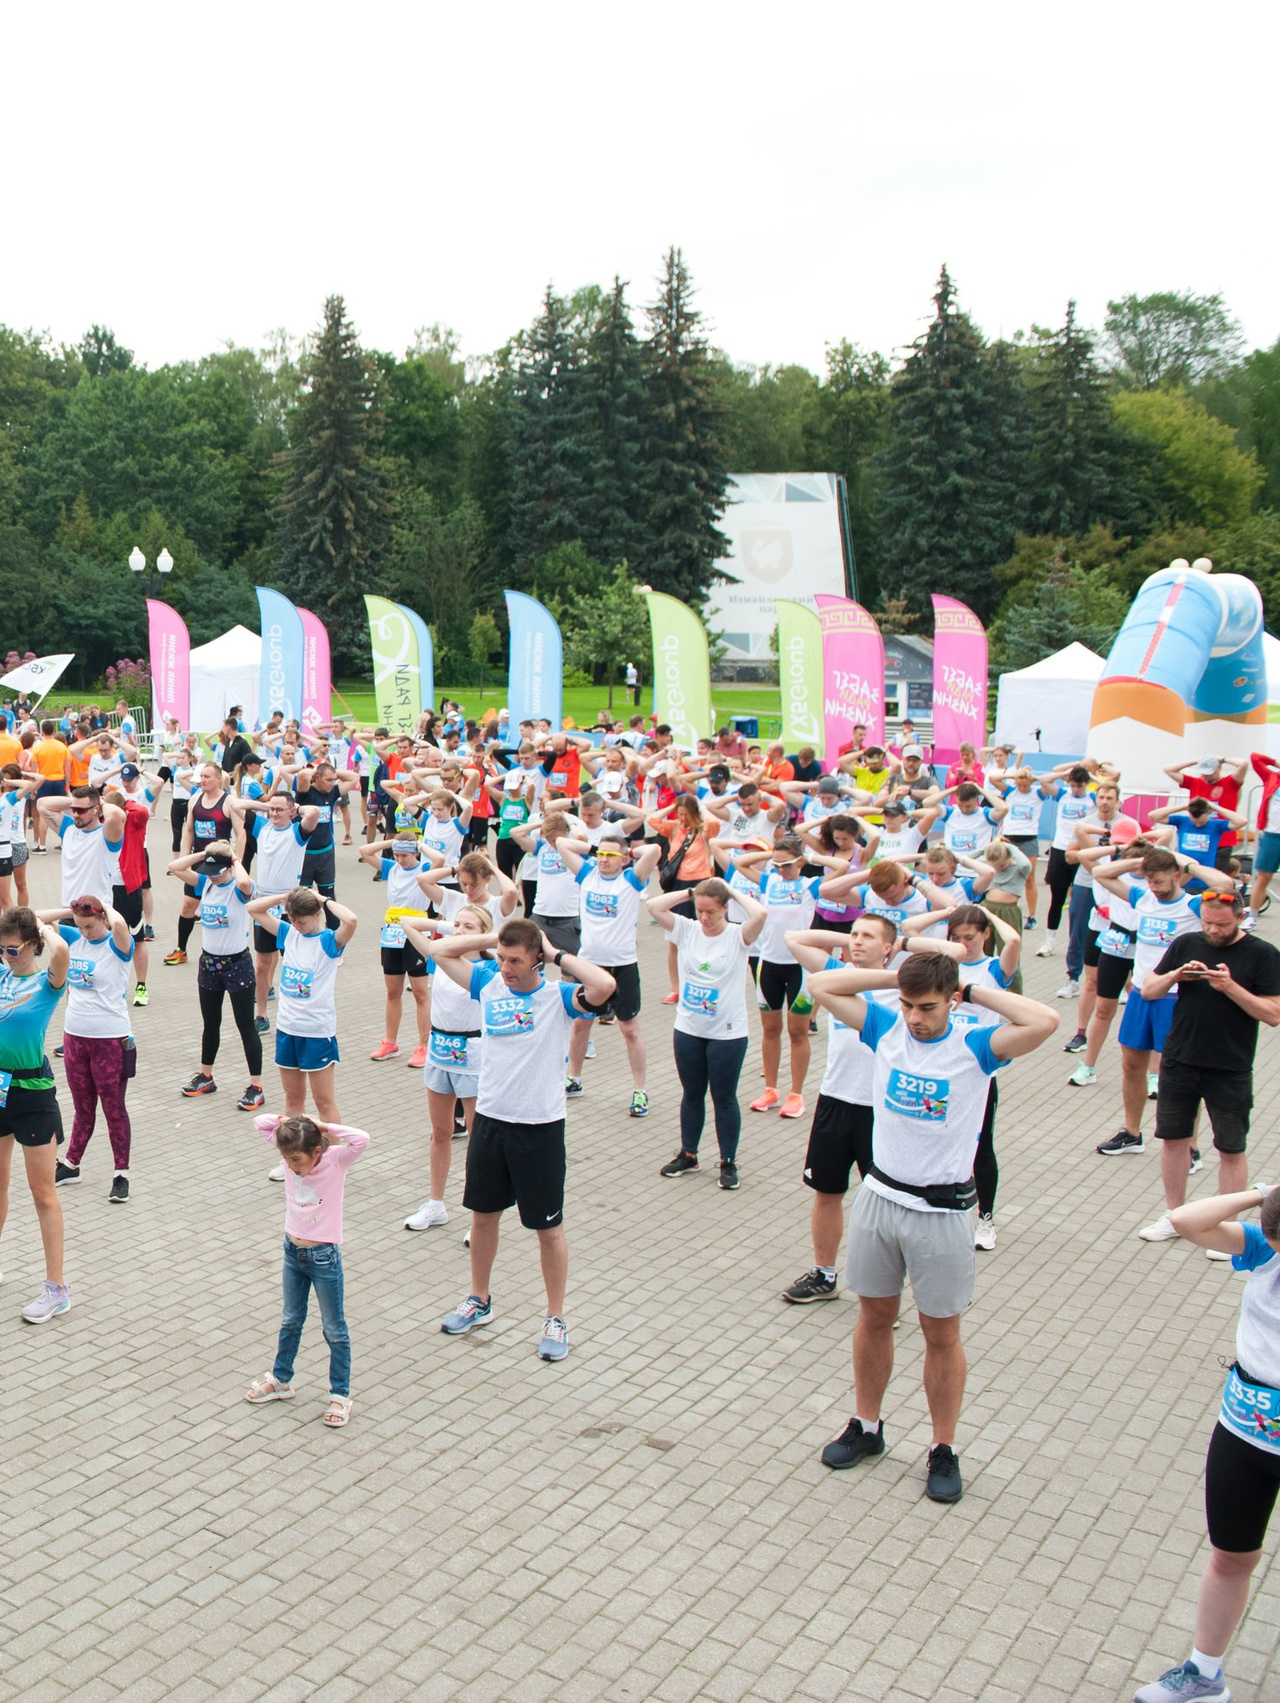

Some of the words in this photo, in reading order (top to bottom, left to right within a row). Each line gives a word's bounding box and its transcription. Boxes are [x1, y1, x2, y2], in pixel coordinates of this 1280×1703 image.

[588, 893, 614, 905] 3082
[202, 905, 223, 915] 3304
[1145, 918, 1169, 930] 3135
[285, 969, 309, 983] 3247
[687, 984, 712, 999] 3217
[491, 998, 524, 1013] 3332
[434, 1034, 461, 1048] 3246
[897, 1073, 938, 1095] 3219
[1229, 1374, 1272, 1411] 3335
